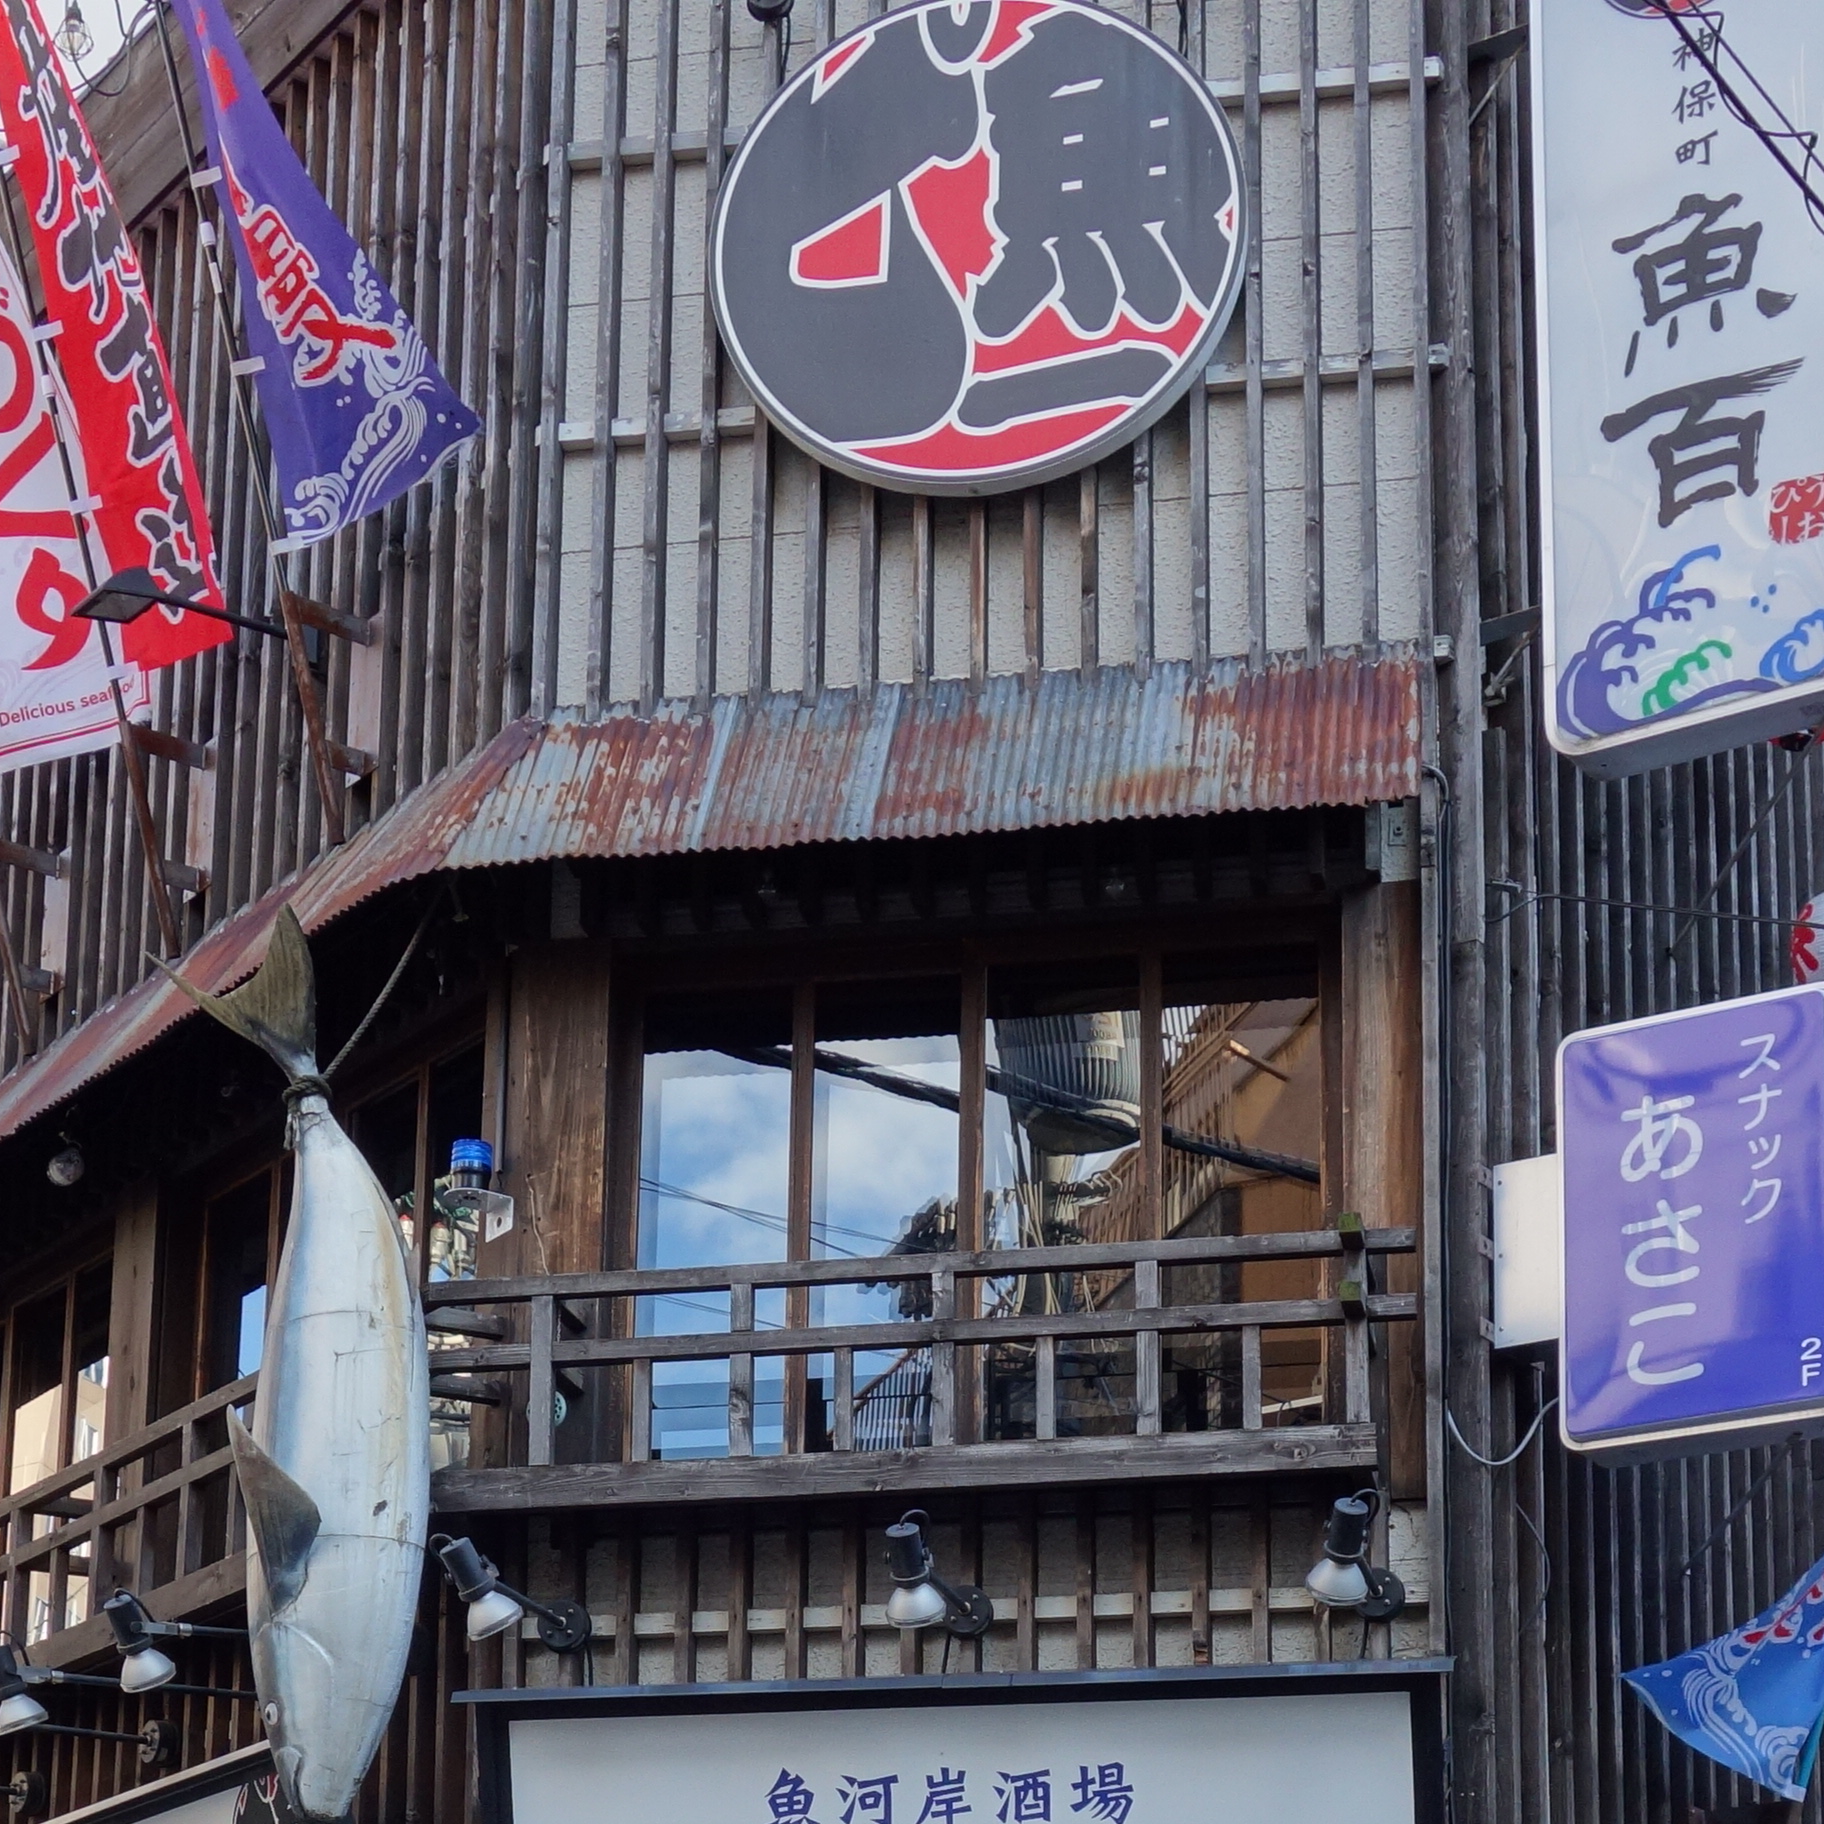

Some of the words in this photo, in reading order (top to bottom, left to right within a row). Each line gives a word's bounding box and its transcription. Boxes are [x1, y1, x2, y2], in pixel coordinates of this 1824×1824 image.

[1672, 25, 1718, 166] 神保町
[1601, 192, 1806, 529] 魚百
[1738, 1033, 1781, 1224] スナック
[1620, 1094, 1705, 1386] あさこ
[1798, 1335, 1824, 1387] 2F
